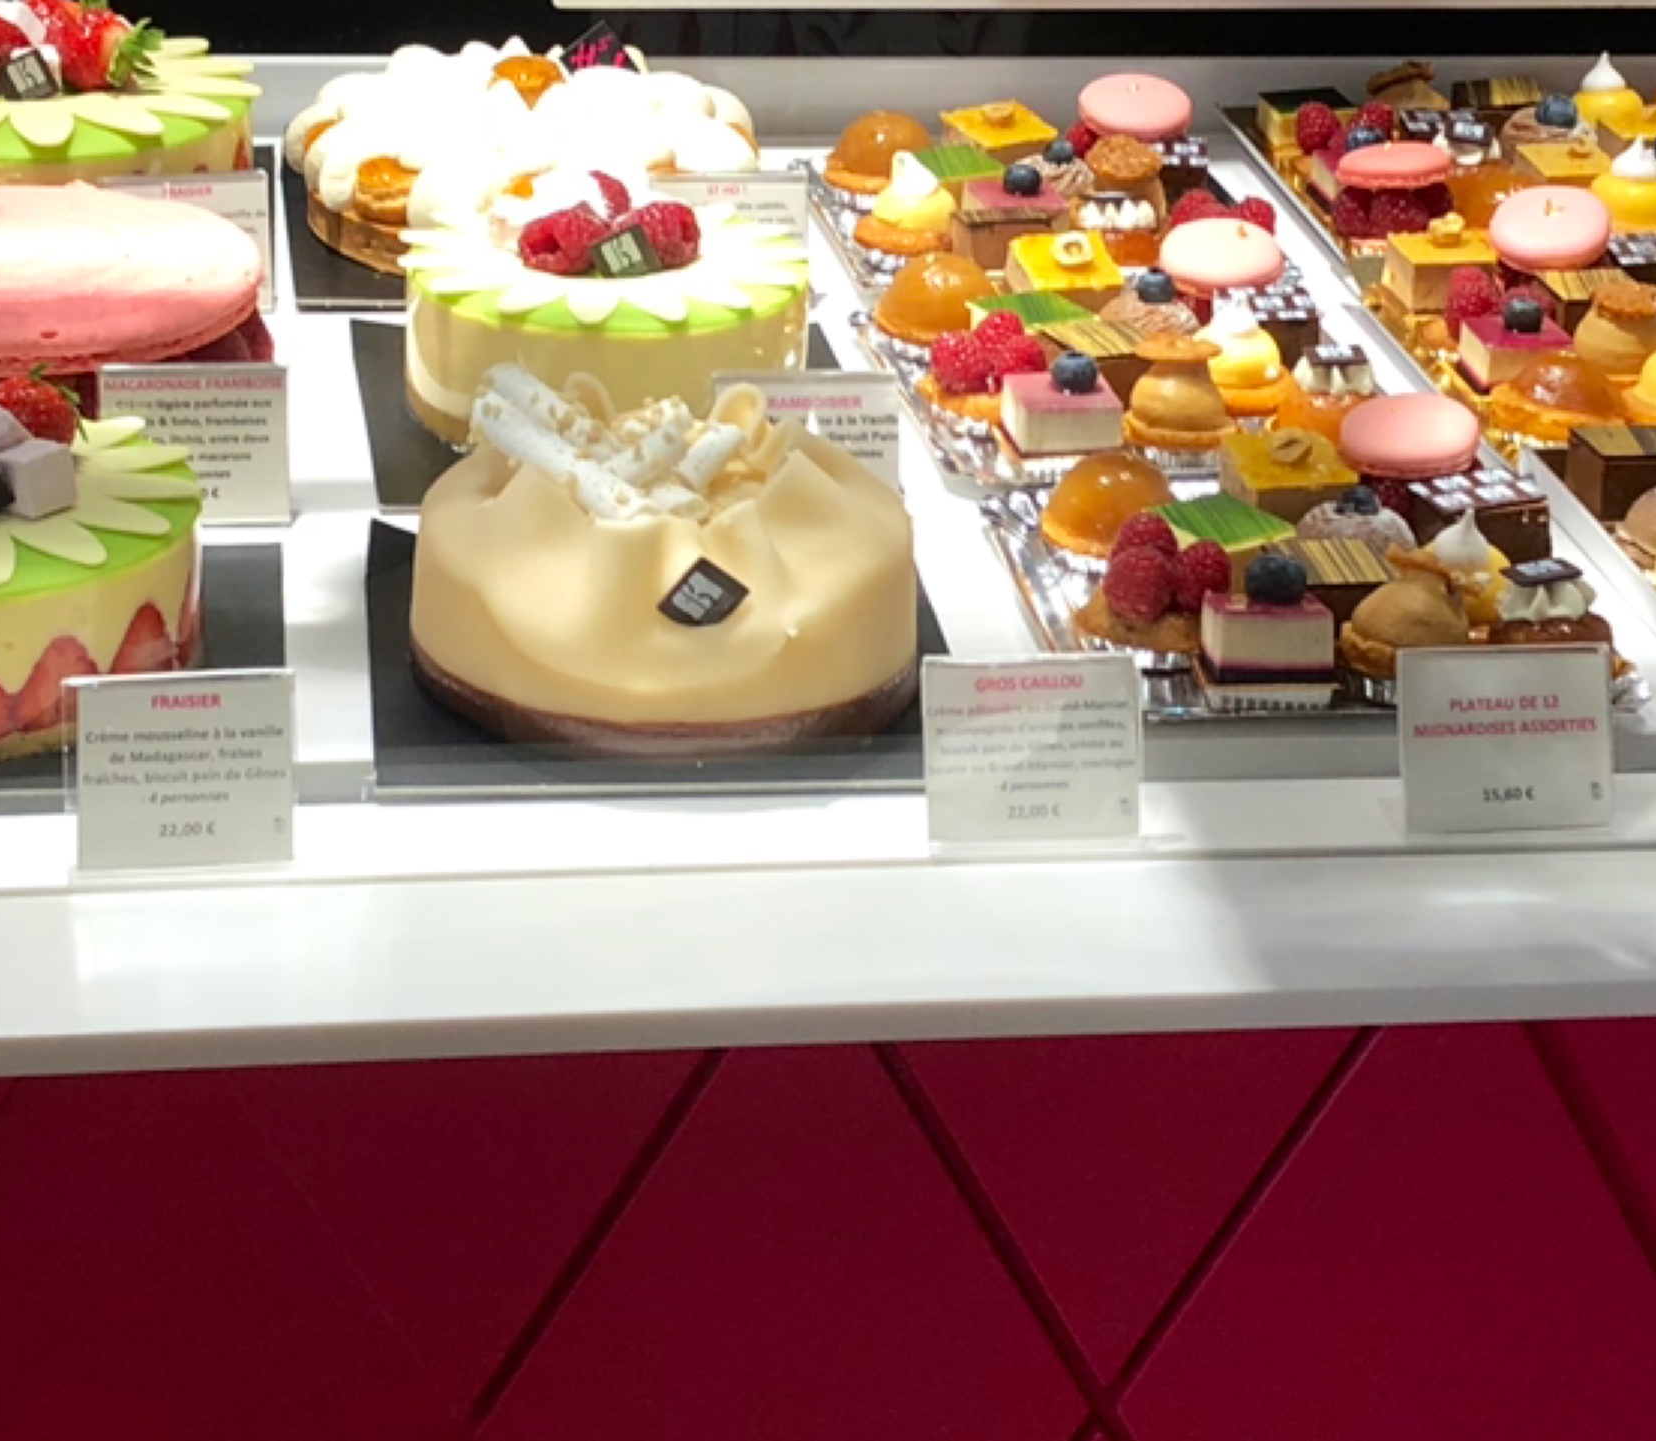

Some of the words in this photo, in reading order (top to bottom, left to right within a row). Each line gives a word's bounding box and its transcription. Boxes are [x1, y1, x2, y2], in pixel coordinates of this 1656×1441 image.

[205, 376, 283, 389] FRAMBOISE
[974, 676, 1017, 692] GROS
[1020, 674, 1085, 690] CAILLOU
[151, 694, 222, 709] FRAISIER
[1450, 697, 1514, 711] PLATEAU
[1519, 696, 1538, 709] DE
[85, 729, 128, 744] Crème
[132, 727, 209, 743] mousseline
[213, 726, 221, 740] à
[223, 726, 236, 740] la
[240, 725, 284, 738] vanille
[1414, 720, 1516, 738] MIGNARDISES
[1519, 717, 1597, 734] ASSORTIES
[109, 751, 126, 765] de
[129, 749, 215, 766] Madagascar,
[218, 747, 263, 760] fraises
[144, 768, 188, 783] biscuit
[192, 768, 221, 785] pain
[224, 768, 242, 781] de
[244, 766, 287, 781] Gênes
[160, 790, 230, 806] personnes
[1482, 787, 1522, 803] 15,60
[1524, 785, 1535, 800] €
[158, 821, 202, 838] 22,00
[205, 820, 217, 835] €
